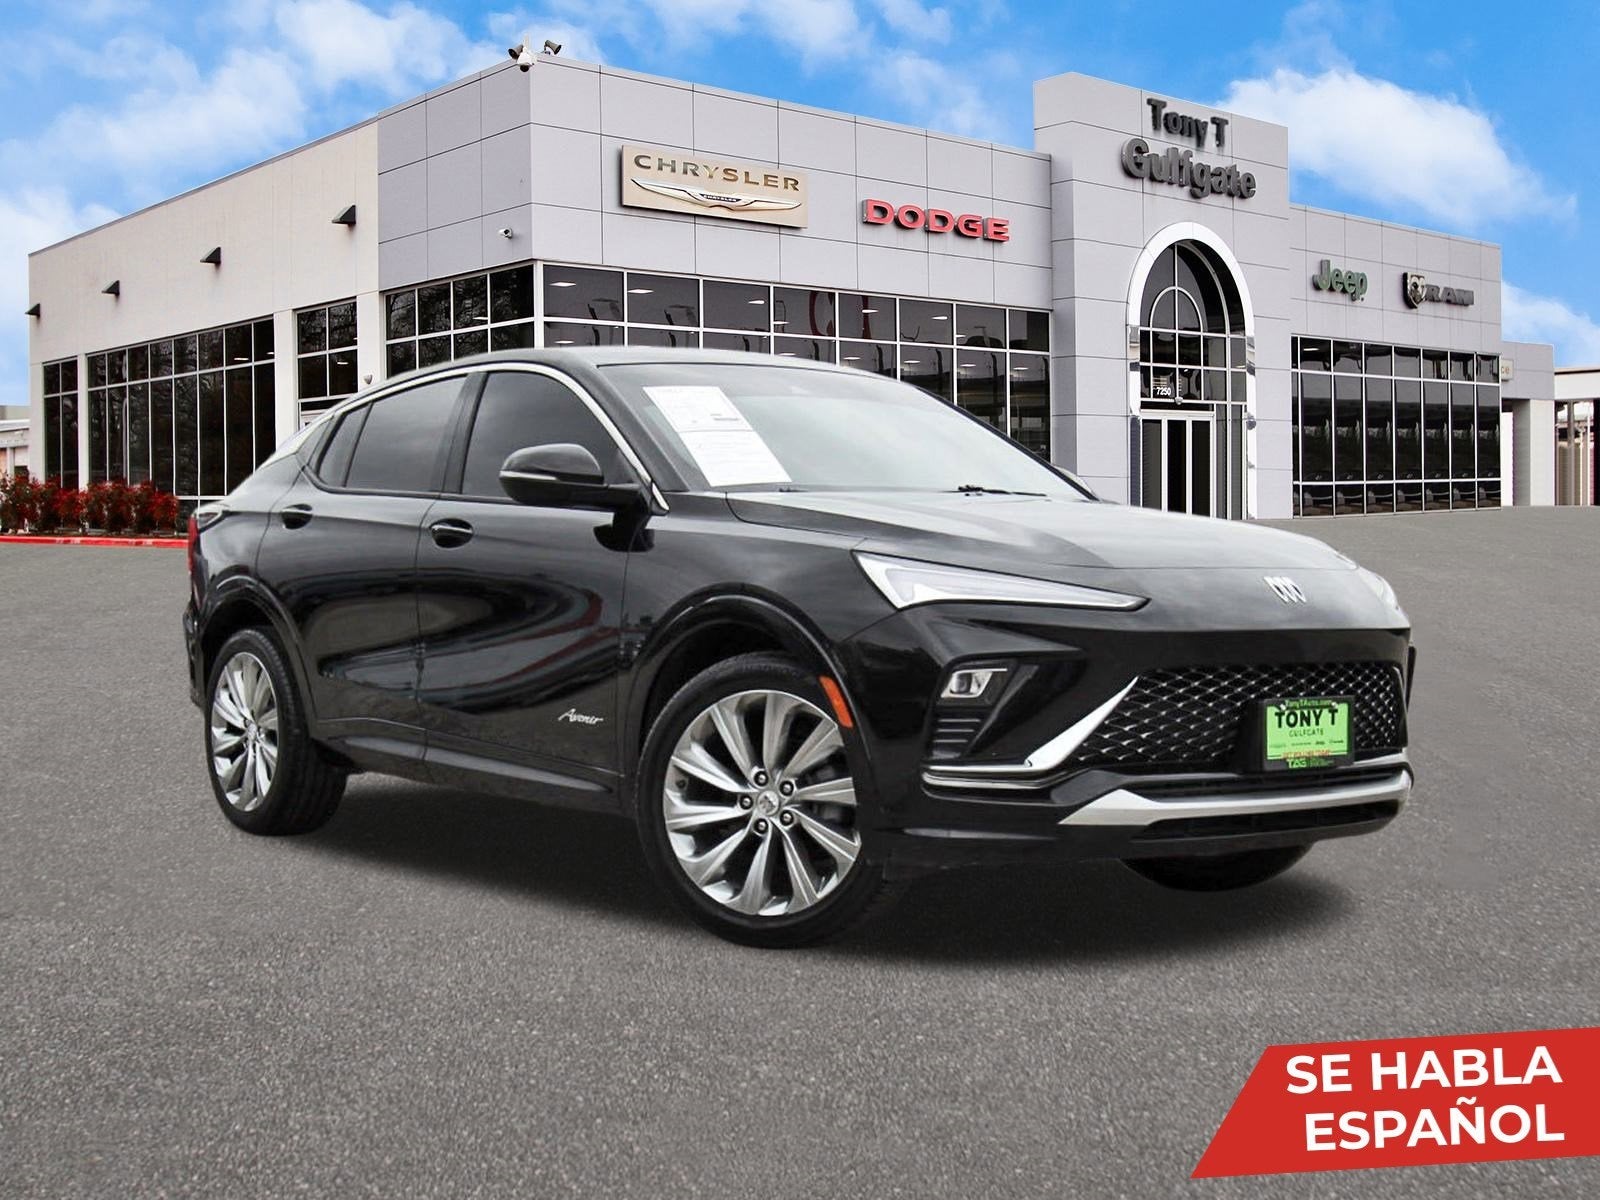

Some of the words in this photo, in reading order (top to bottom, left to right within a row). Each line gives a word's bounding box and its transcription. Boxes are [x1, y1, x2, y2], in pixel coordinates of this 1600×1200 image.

[1147, 98, 1208, 148] Tony
[1211, 117, 1229, 147] T
[633, 154, 800, 191] CHRYSLER
[1121, 138, 1256, 198] Gulfgate
[863, 199, 1011, 242] DODGE
[1312, 259, 1368, 301] Jeep
[1424, 284, 1475, 306] RAM
[1274, 709, 1323, 728] TONY
[1328, 708, 1338, 726] T
